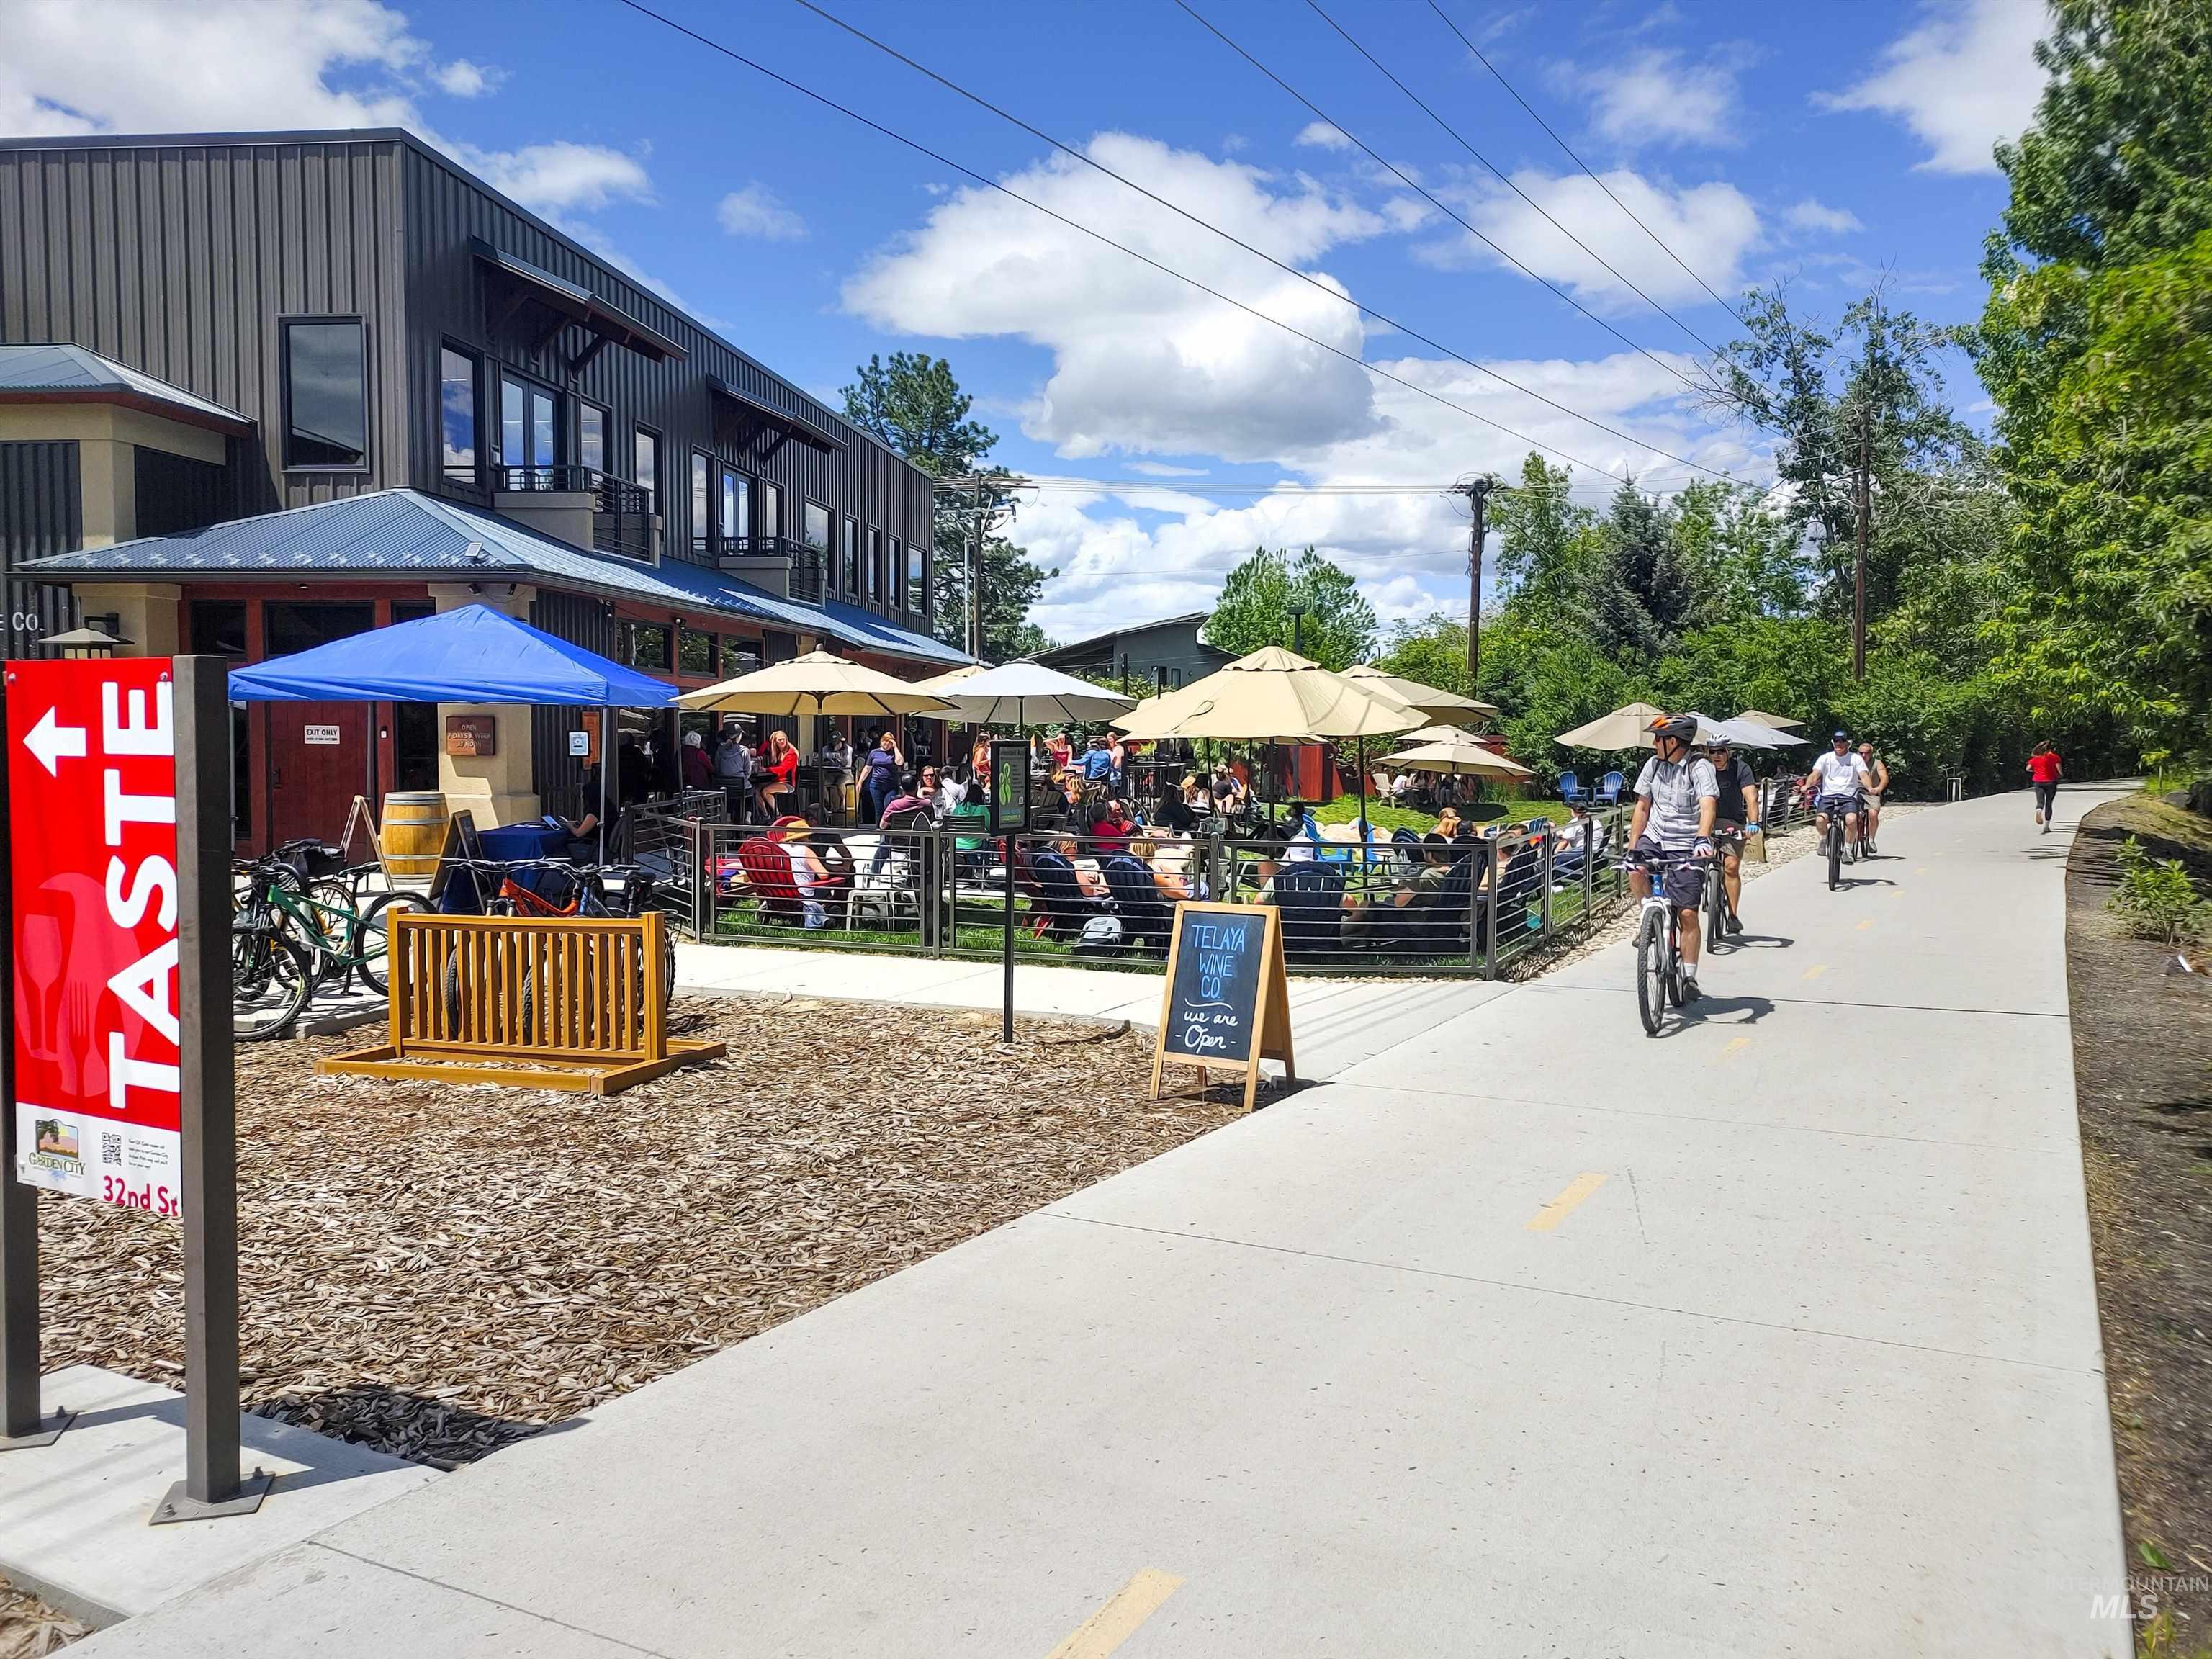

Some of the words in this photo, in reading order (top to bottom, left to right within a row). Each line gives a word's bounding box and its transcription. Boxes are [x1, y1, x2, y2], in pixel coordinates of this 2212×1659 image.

[102, 681, 180, 1109] TASTE
[1191, 925, 1245, 952] TELAYA
[1198, 953, 1233, 978] WINE
[1184, 1010, 1210, 1023] we
[1213, 1012, 1238, 1026] are
[29, 1152, 63, 1170] GARDEN
[63, 1160, 86, 1175] CITY
[103, 1175, 150, 1210] 32nd
[158, 1186, 178, 1216] St
